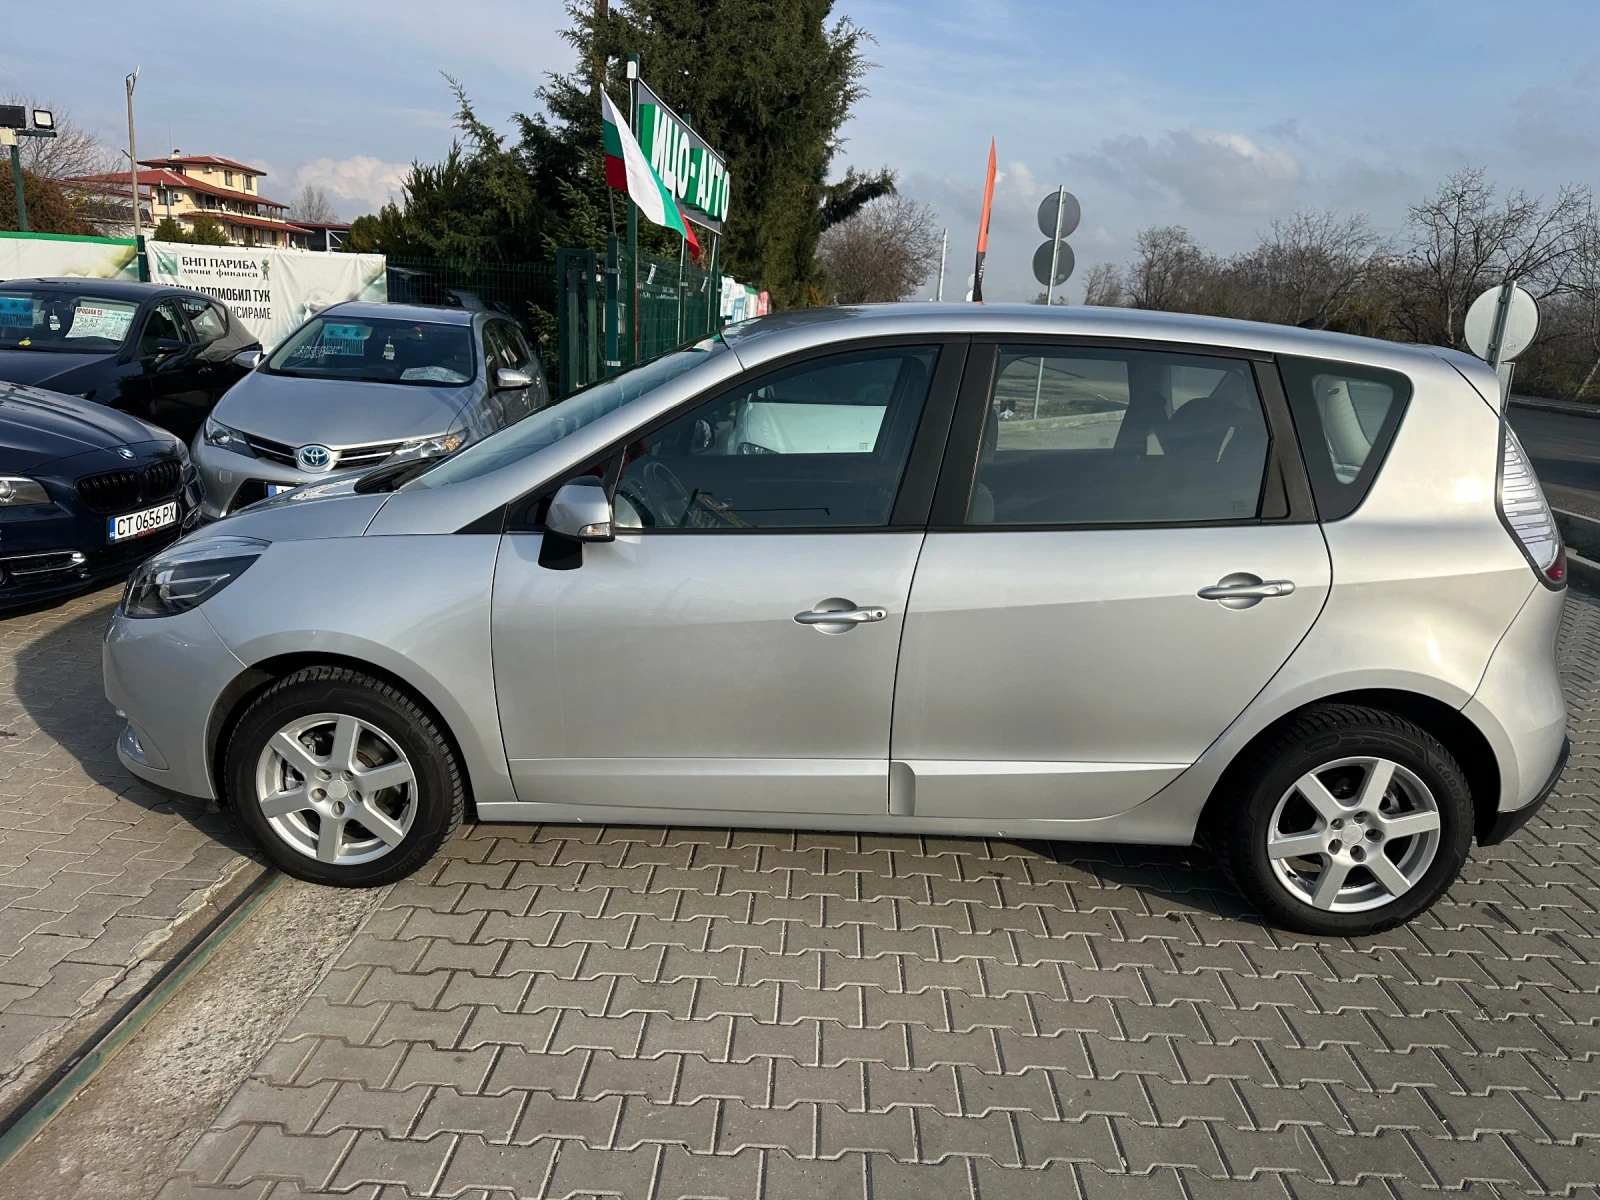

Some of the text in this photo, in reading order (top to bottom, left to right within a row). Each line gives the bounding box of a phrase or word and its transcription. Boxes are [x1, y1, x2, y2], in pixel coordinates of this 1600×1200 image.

[651, 104, 730, 223] ИЦО-АУТО
[182, 256, 257, 270] БНП ПАРИБА
[182, 268, 258, 278] лични финанси
[253, 289, 271, 302] ТУК
[117, 516, 133, 536] CT
[135, 509, 161, 531] 0656
[163, 503, 175, 524] PX
